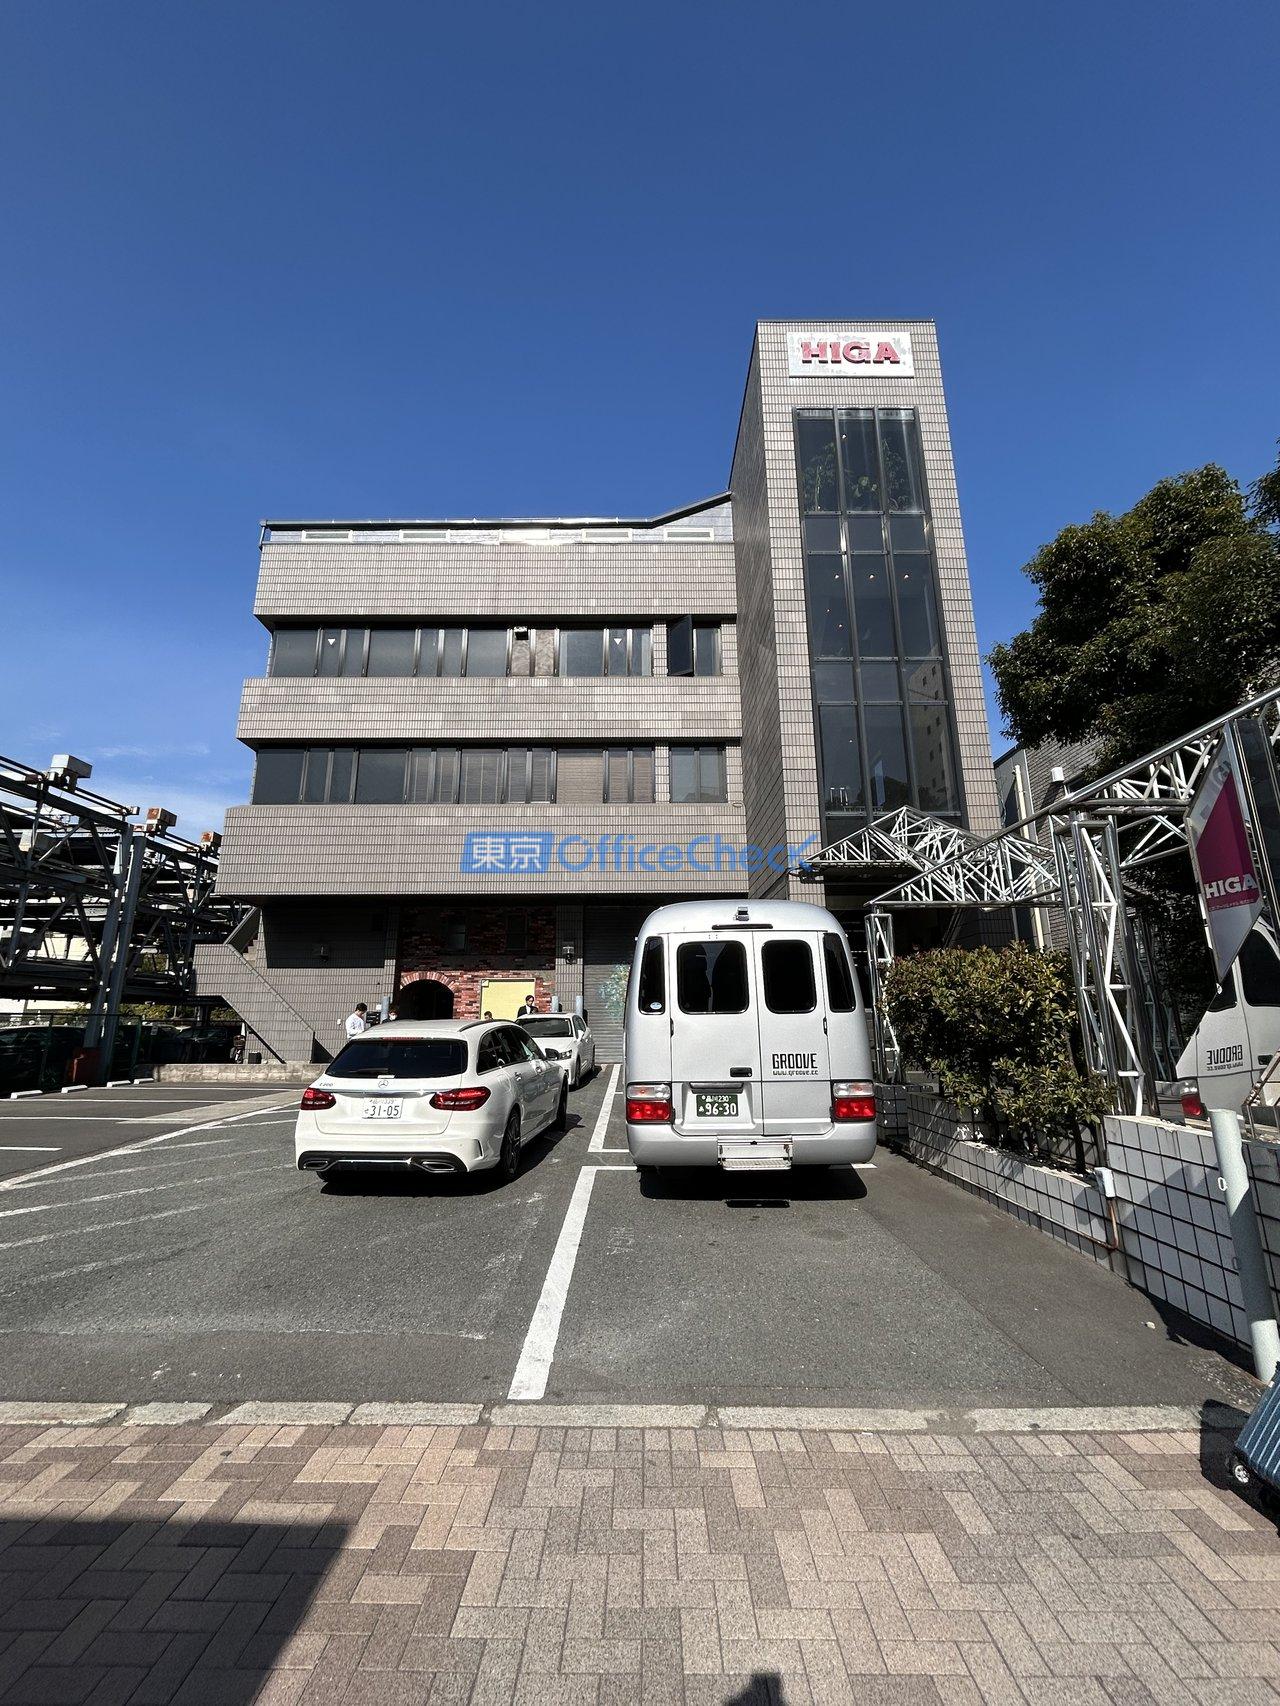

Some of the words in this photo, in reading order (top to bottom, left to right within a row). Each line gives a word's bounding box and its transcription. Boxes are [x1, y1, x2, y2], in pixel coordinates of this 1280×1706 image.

[801, 341, 900, 364] HIGA
[1203, 873, 1257, 899] HIGA
[772, 1053, 818, 1069] GROOVE
[370, 1105, 400, 1116] 31-05
[705, 1102, 737, 1115] 96-30
